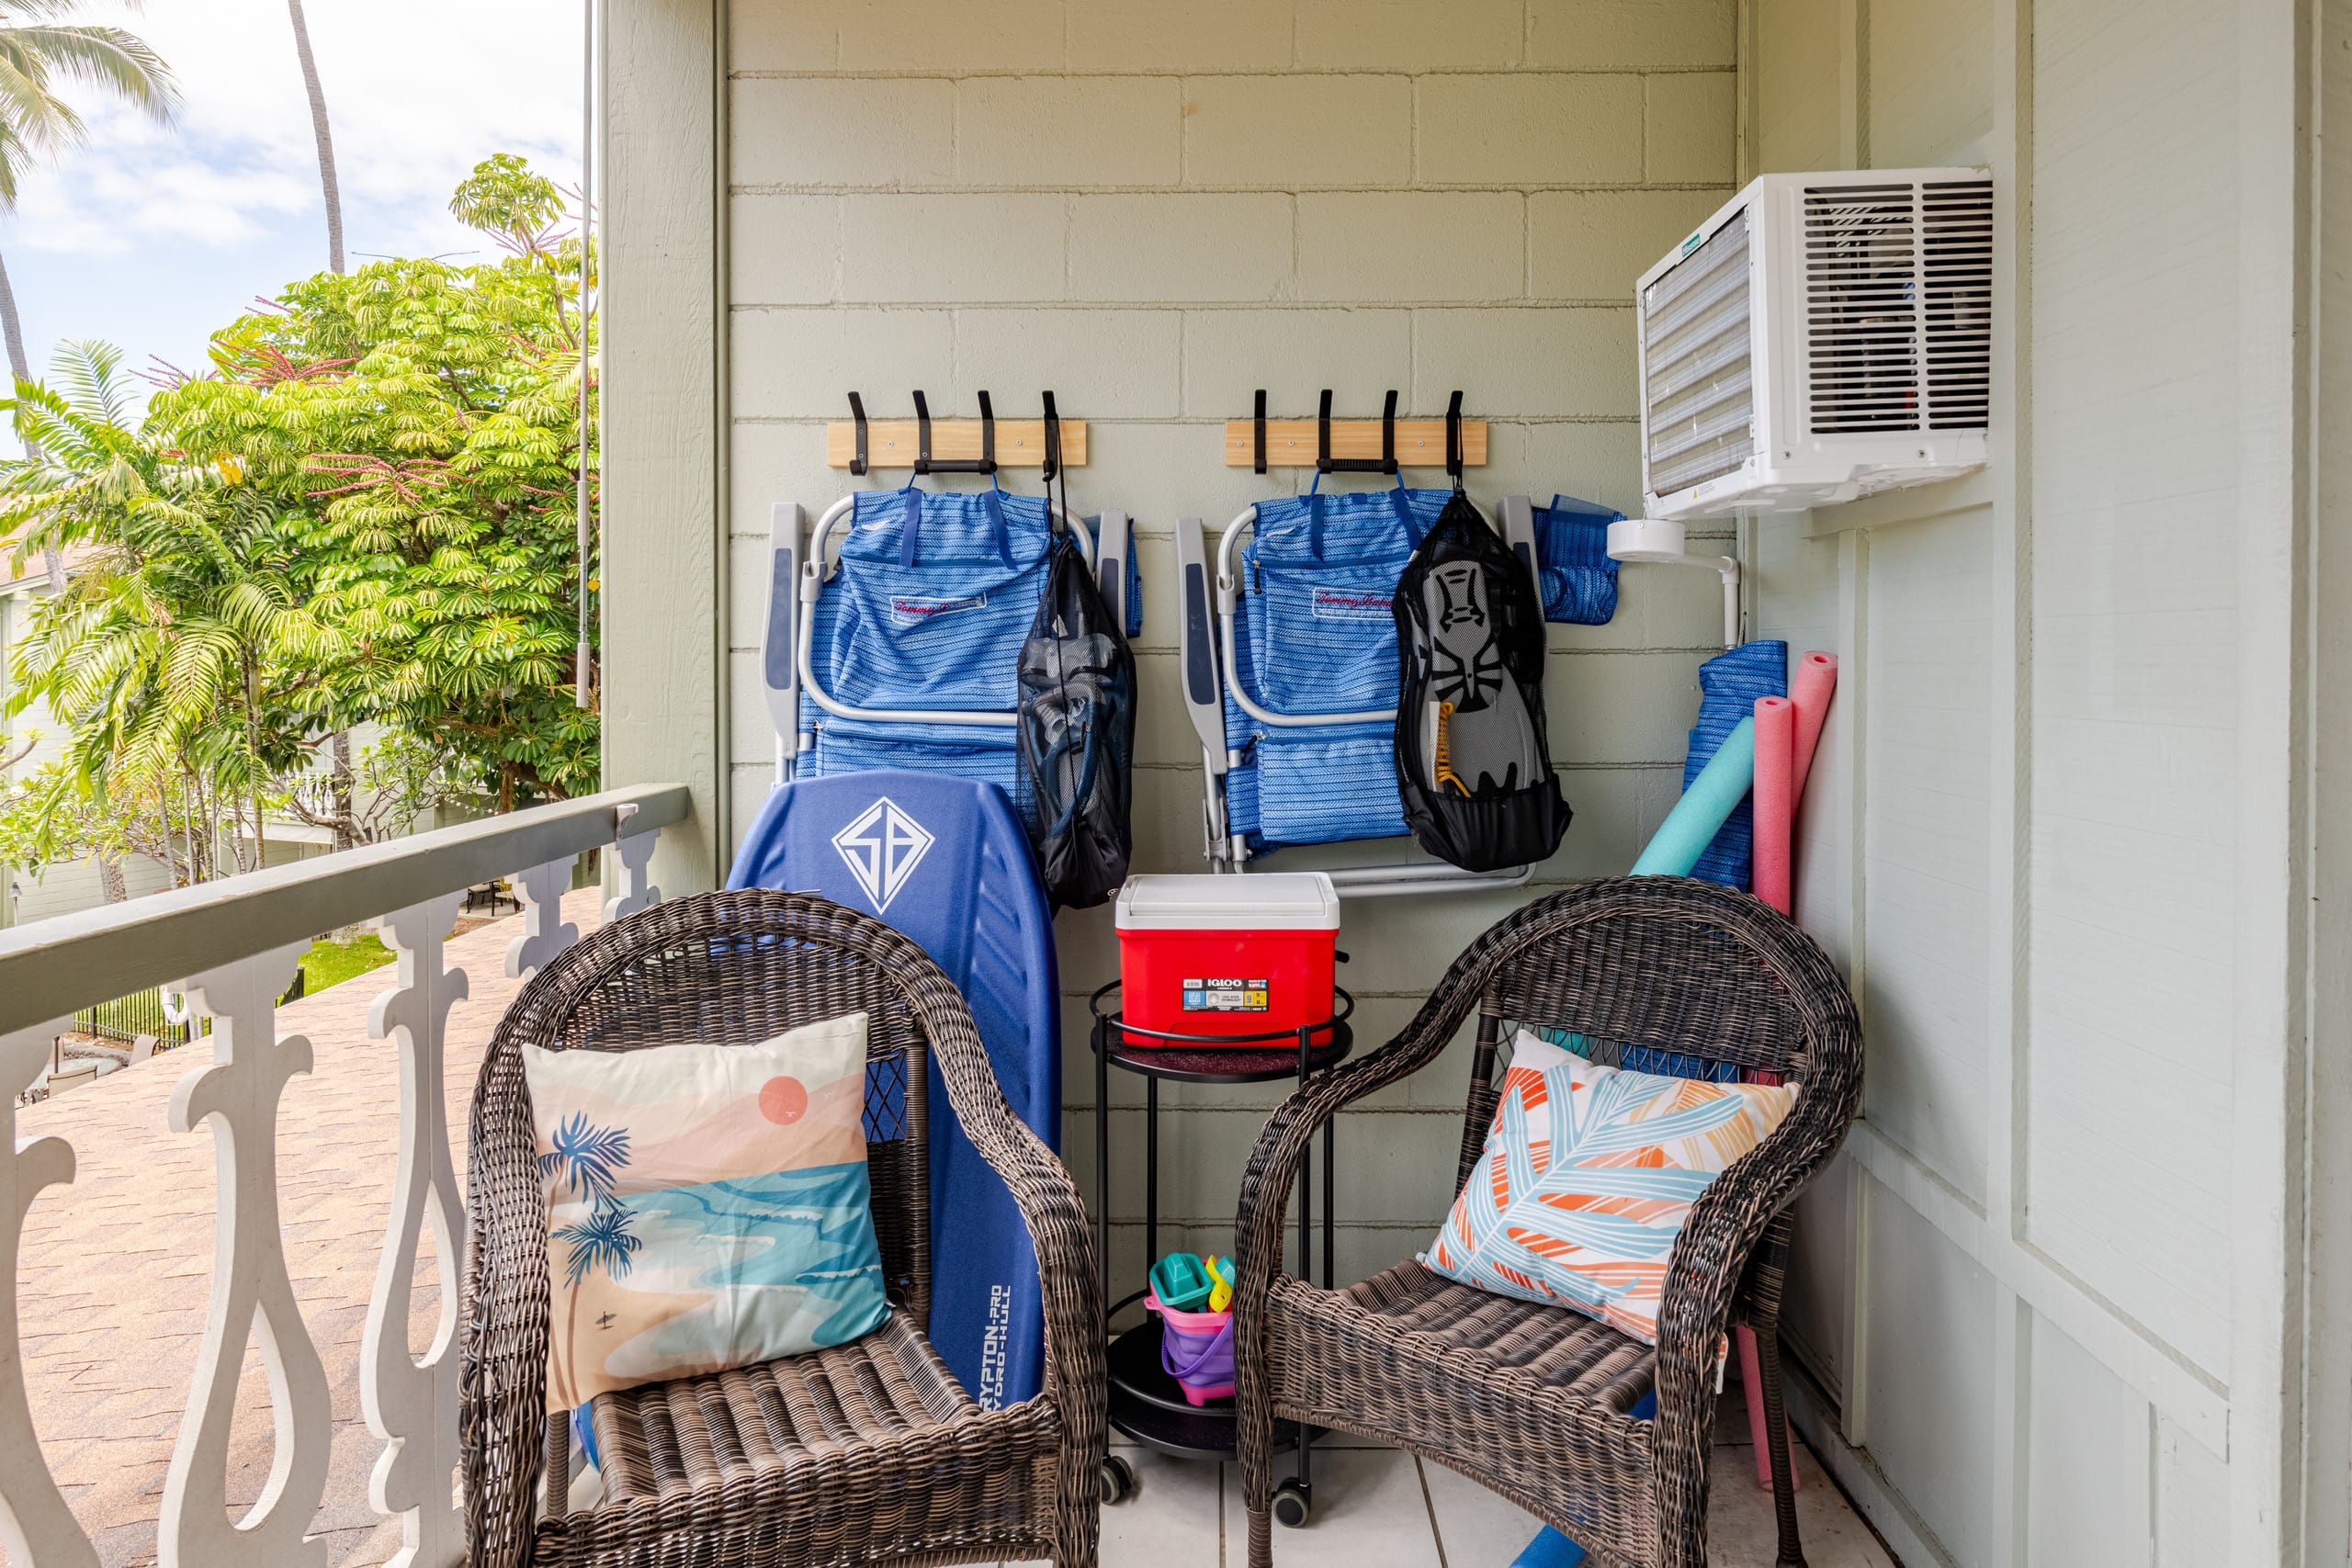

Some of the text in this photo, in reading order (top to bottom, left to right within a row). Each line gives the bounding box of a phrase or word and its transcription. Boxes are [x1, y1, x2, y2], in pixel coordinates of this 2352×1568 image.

[895, 601, 935, 617] Tommy
[1207, 978, 1242, 987] IGLOO
[979, 1285, 1002, 1412] RYPTON-PRO
[993, 1285, 1011, 1412] YDRO-HULL
